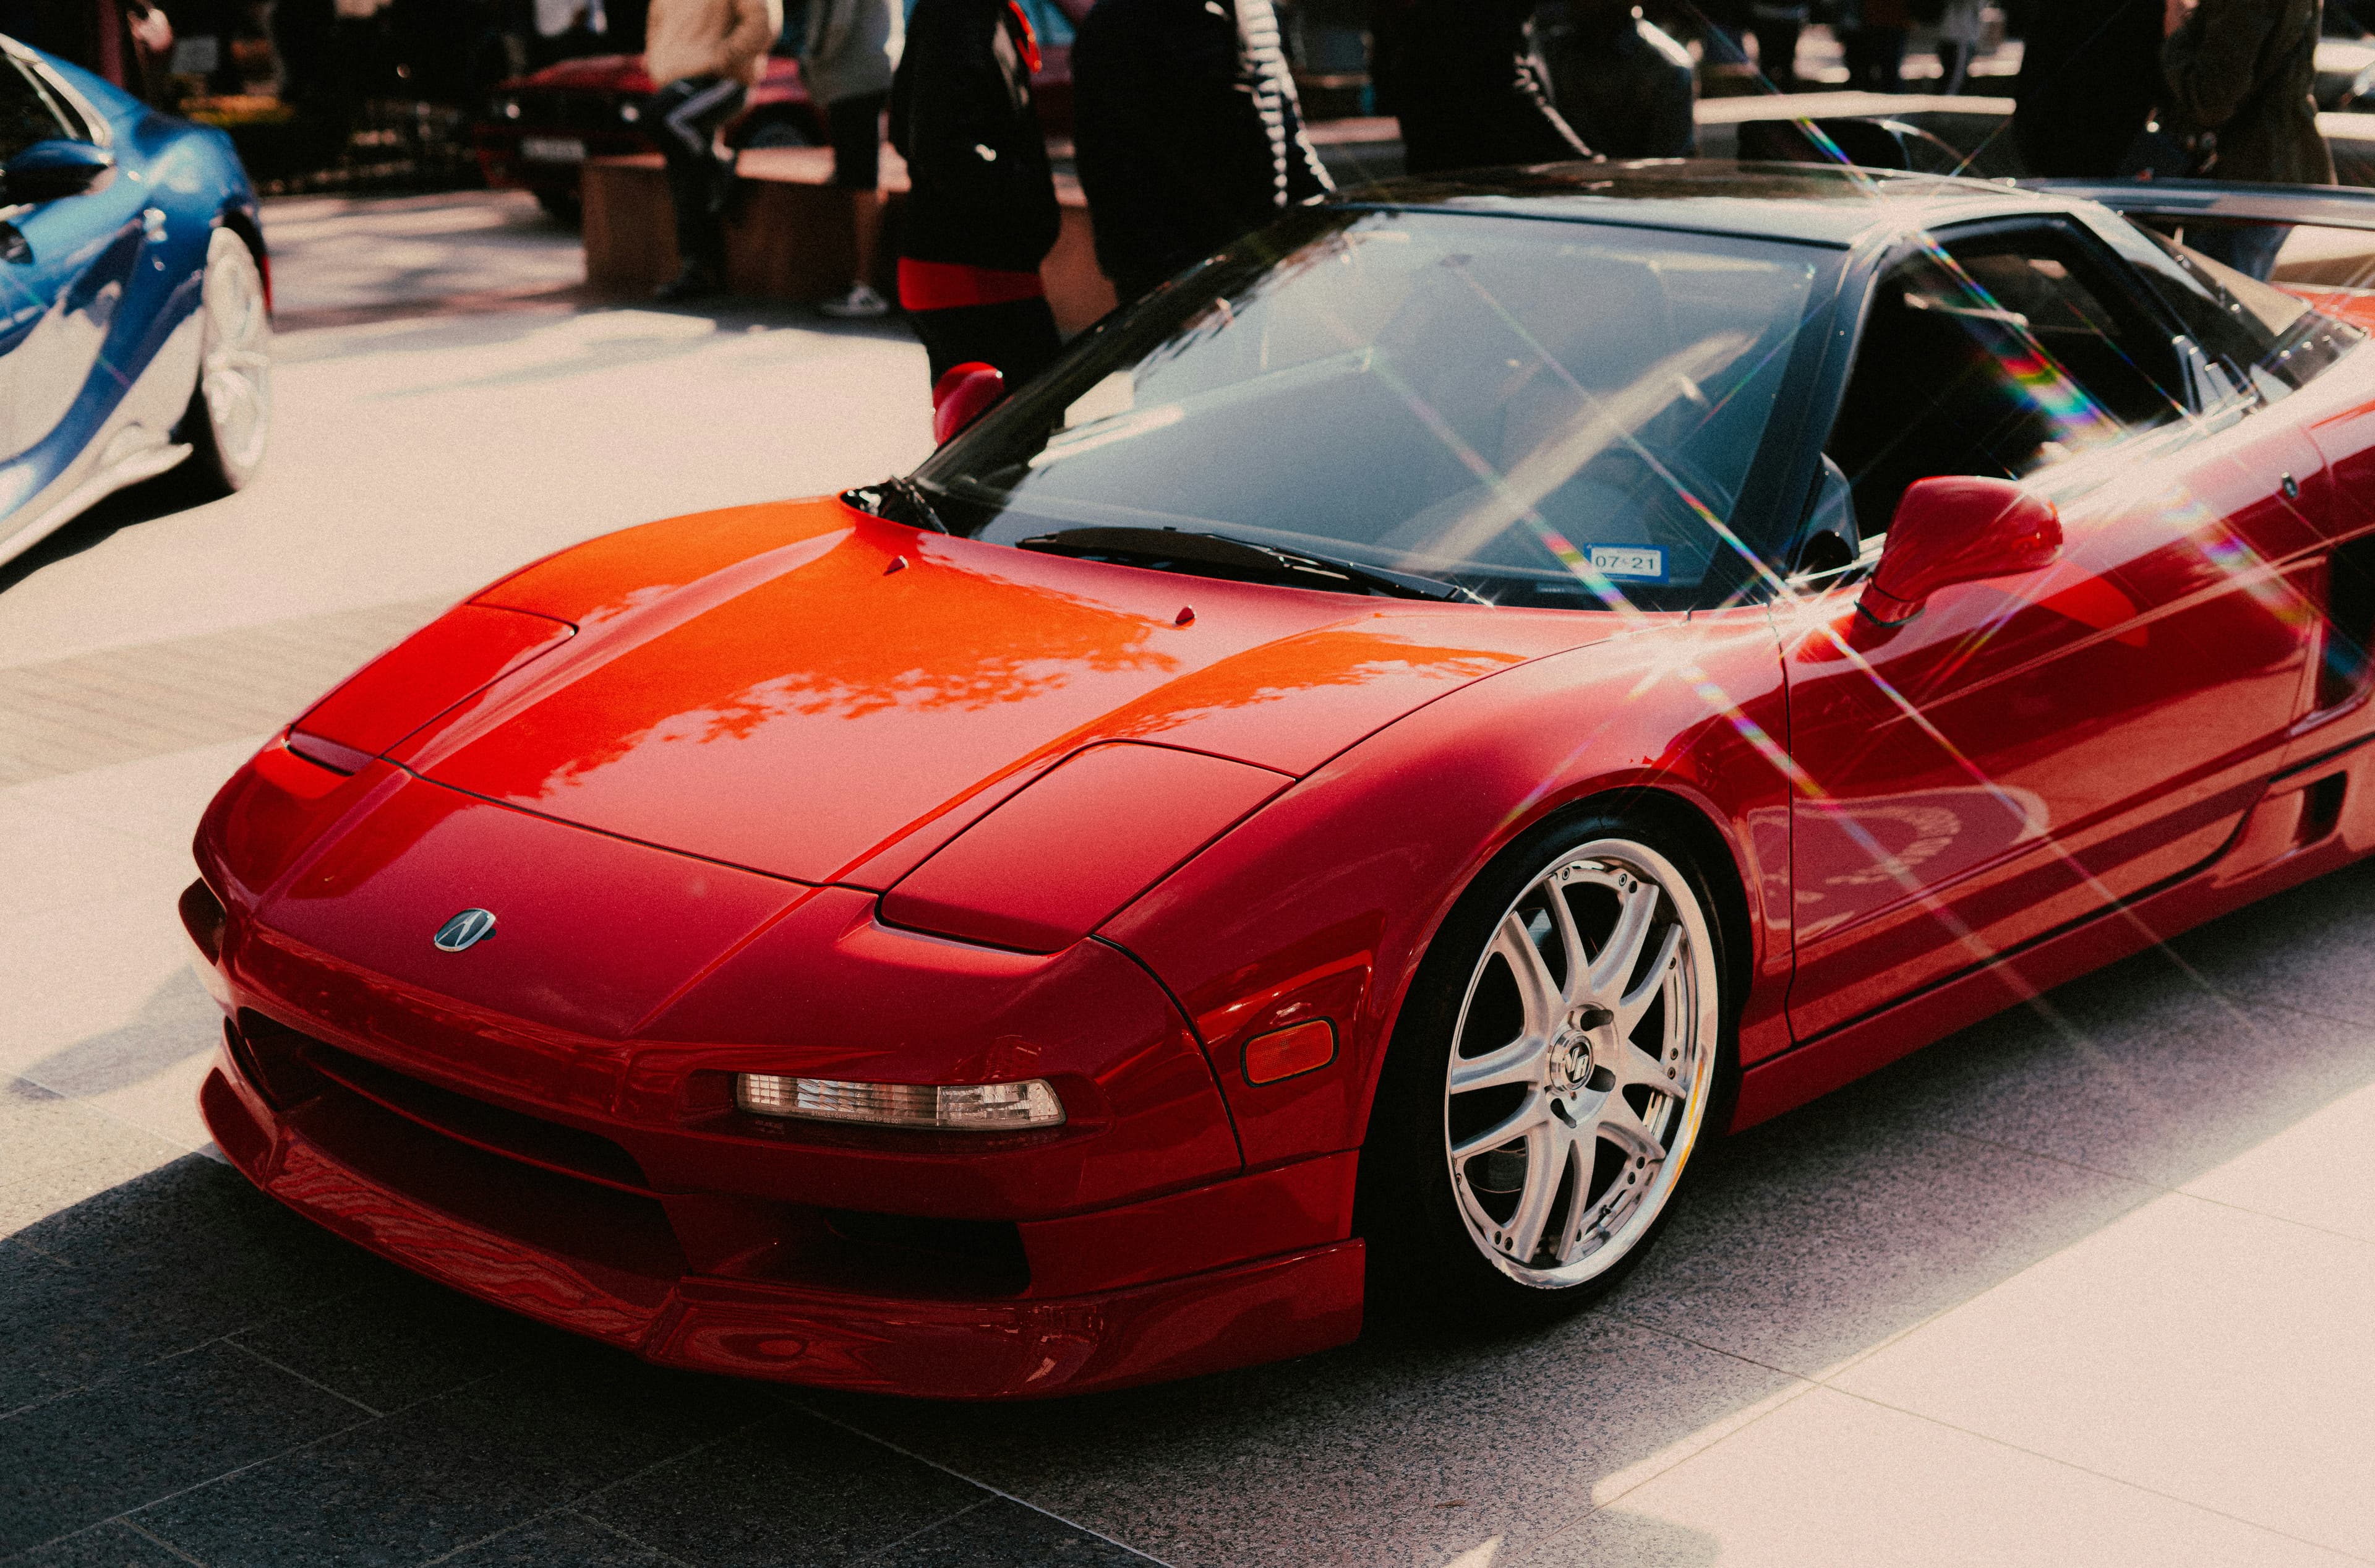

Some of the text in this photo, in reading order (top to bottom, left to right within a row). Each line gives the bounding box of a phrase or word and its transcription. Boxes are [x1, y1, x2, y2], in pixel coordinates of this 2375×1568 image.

[1595, 556, 1654, 570] 07 21
[1564, 1047, 1589, 1082] VR
